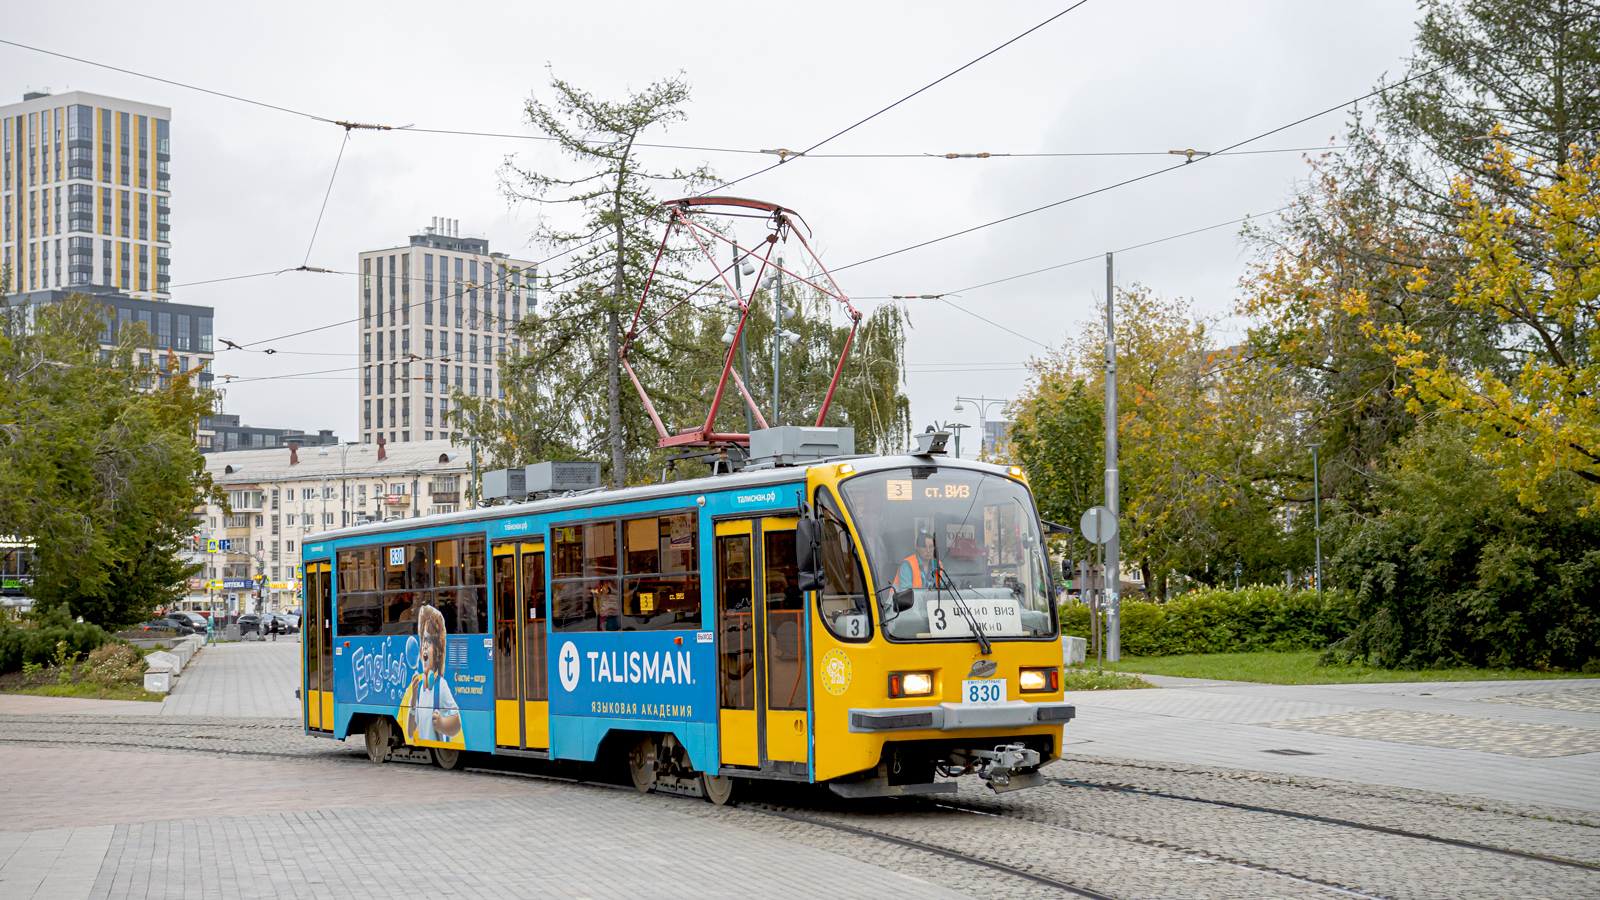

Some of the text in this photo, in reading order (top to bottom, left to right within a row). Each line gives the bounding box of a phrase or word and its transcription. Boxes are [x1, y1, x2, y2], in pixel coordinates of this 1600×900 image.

[737, 491, 776, 504] талисман.рф
[895, 484, 903, 496] 3
[925, 484, 970, 498] ст. ВИЗ
[391, 549, 403, 564] 830
[993, 606, 1015, 616] ВИЗ
[851, 618, 860, 637] 3
[934, 608, 947, 631] 3
[352, 642, 407, 703] English
[587, 651, 691, 685] TALISMAN
[454, 672, 470, 682] Састье
[969, 685, 1000, 702] 830
[591, 701, 692, 718] ЯЗЫКОВАЯ АКАДЕМИЯ
